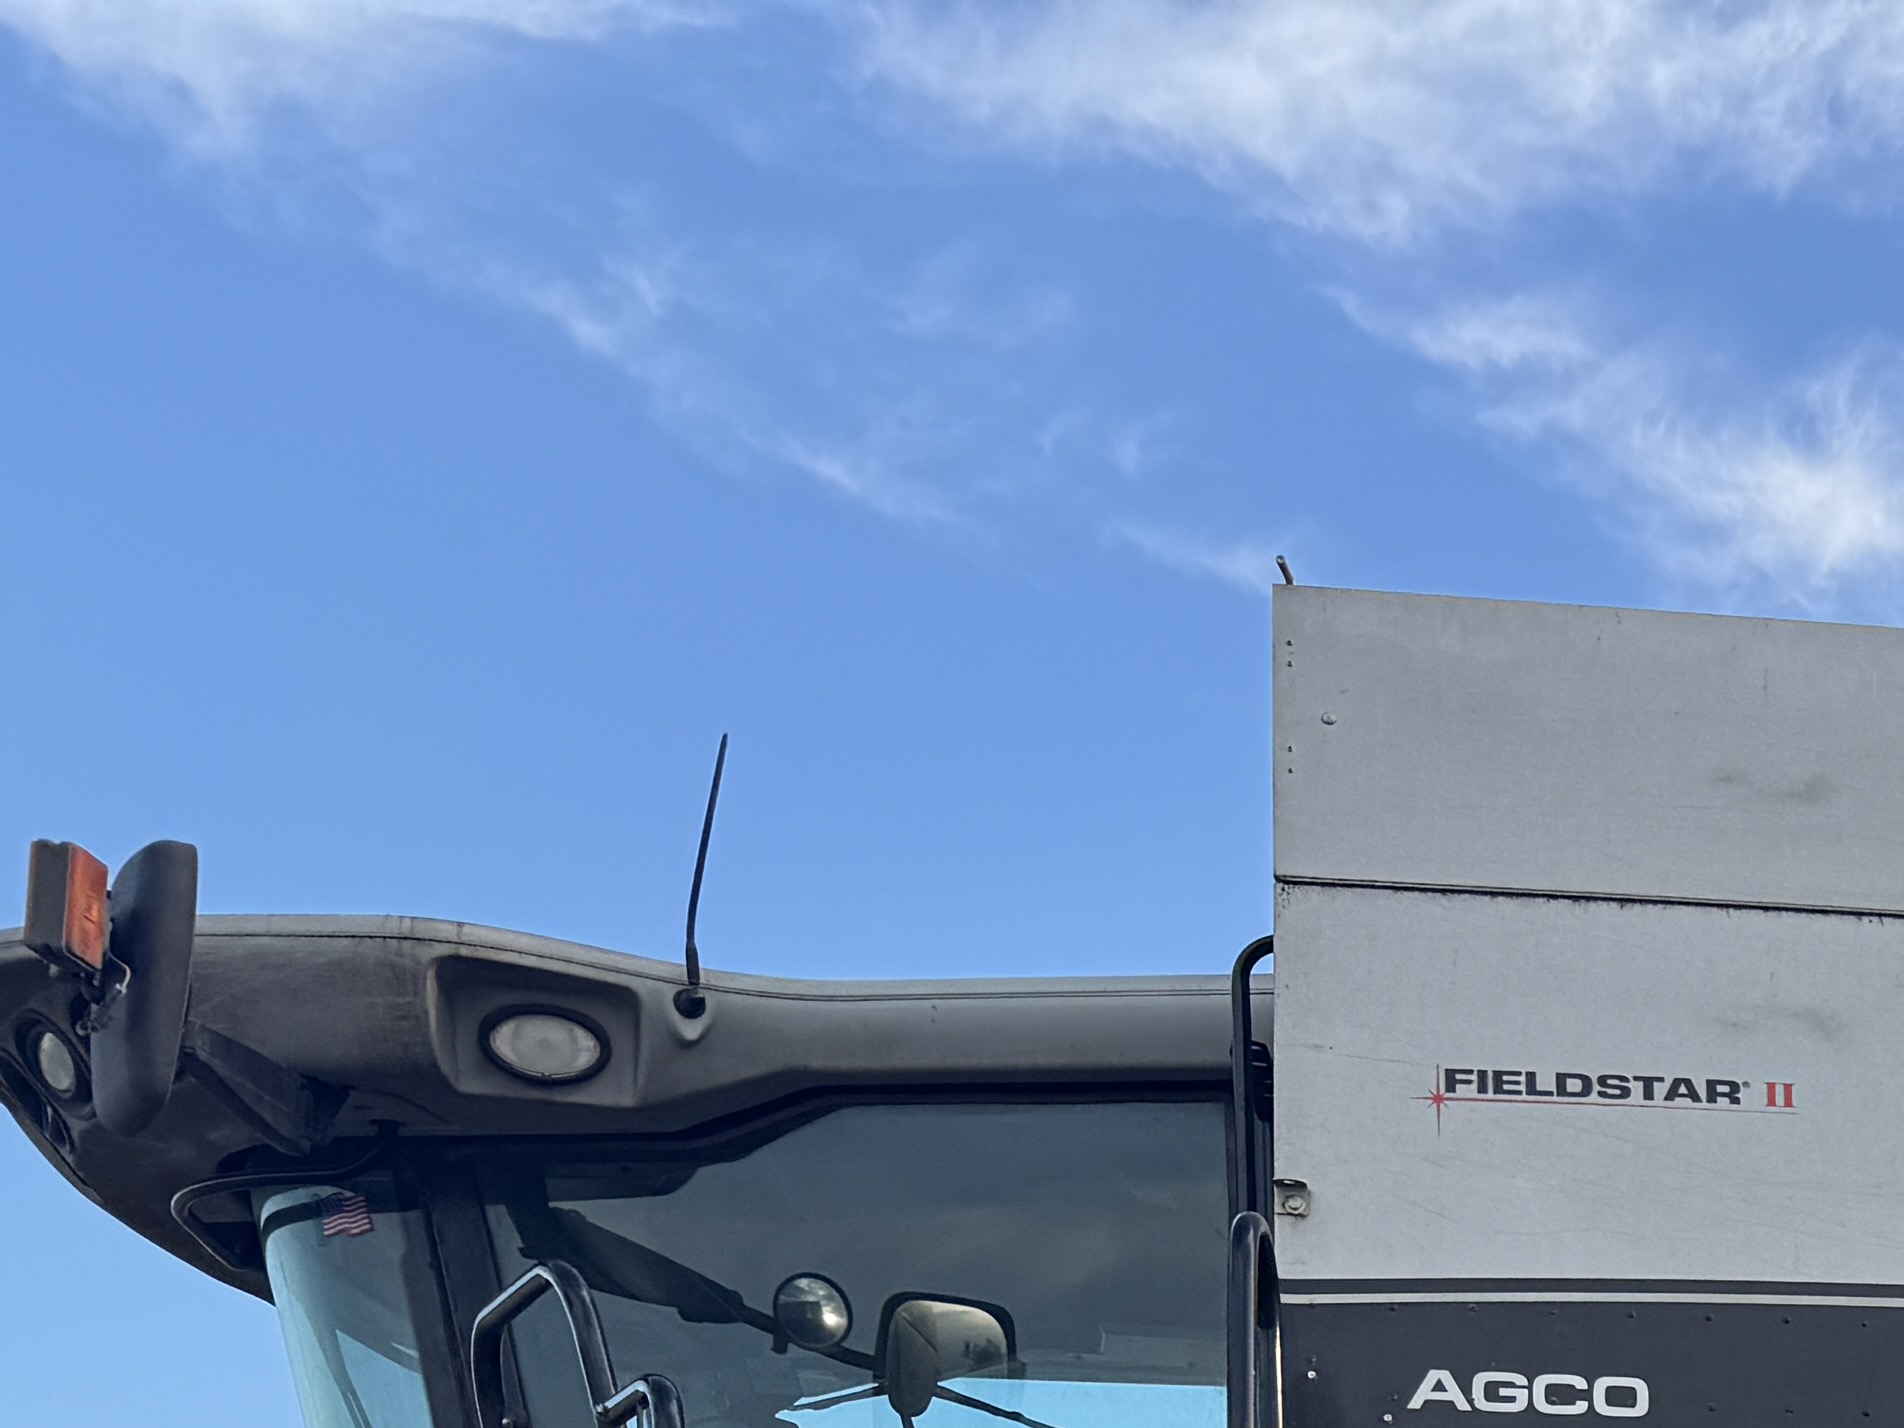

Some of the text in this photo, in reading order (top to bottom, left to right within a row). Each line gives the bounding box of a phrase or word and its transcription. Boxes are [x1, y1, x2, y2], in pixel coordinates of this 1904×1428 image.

[1444, 1068, 1798, 1108] FIELDSTAR II
[1406, 1369, 1650, 1417] AGCO
